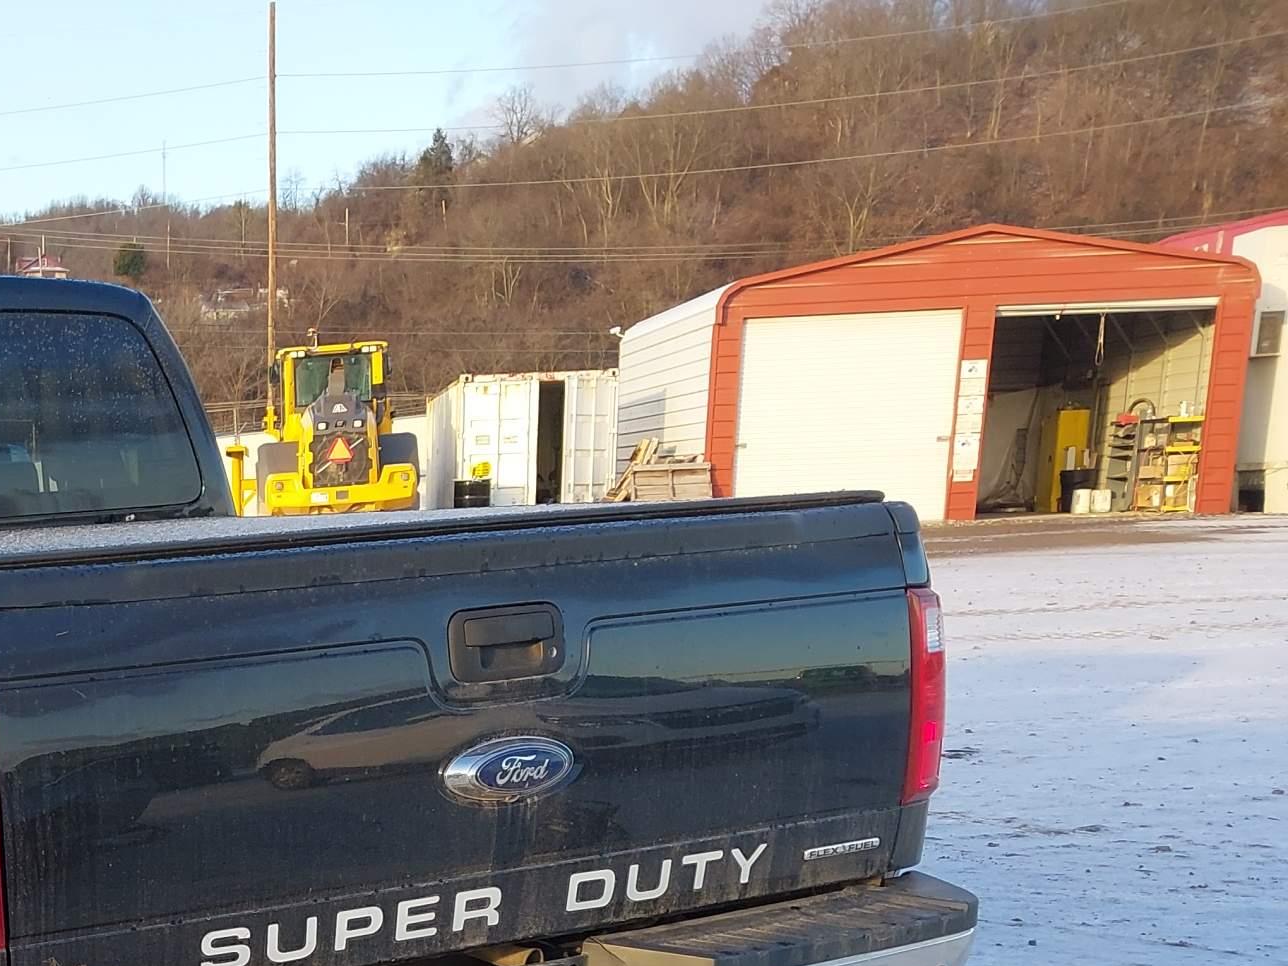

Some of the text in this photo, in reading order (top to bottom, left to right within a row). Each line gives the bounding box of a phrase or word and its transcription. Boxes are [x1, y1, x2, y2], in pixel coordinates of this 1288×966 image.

[495, 754, 550, 786] Ford
[808, 840, 877, 859] FLEX FUEL
[566, 843, 769, 912] DUTY
